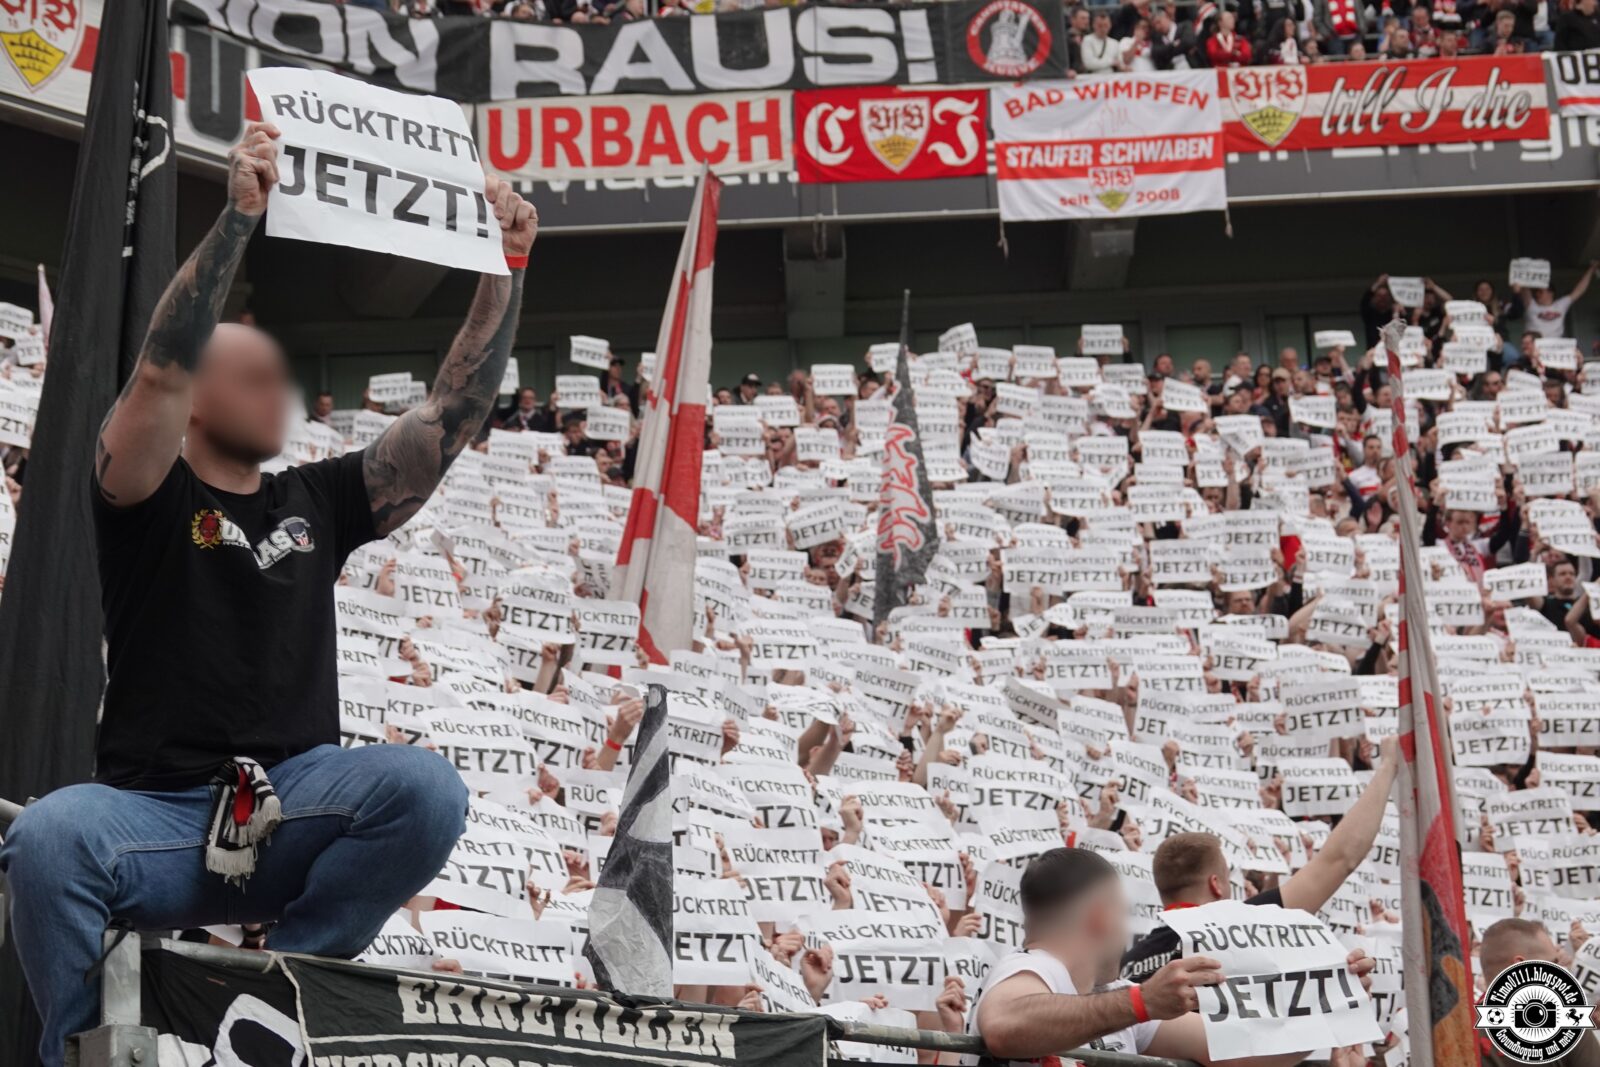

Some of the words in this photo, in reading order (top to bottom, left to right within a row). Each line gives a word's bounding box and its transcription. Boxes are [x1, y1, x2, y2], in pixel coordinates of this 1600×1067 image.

[490, 7, 937, 101] RAUS!
[1004, 88, 1064, 119] BAD
[1074, 81, 1209, 110] WIMPFEN
[1321, 67, 1407, 136] till
[1462, 67, 1531, 129] die
[271, 91, 479, 162] RÜCKTRITT
[488, 98, 783, 170] URBACH
[1006, 144, 1093, 167] STAUFER
[1100, 137, 1214, 164] SCHWABEN
[279, 146, 488, 238] JETZT!
[1060, 196, 1089, 206] seit
[1137, 189, 1180, 203] 2008
[794, 518, 843, 541] JETZT!
[1153, 561, 1208, 573] JETZT!
[401, 586, 462, 608] JETZT!
[1434, 602, 1481, 617] ETZT!
[338, 601, 399, 626] RÜCKTRITT
[752, 645, 818, 659] JETZT!
[1047, 664, 1108, 679] JETZT!
[1285, 688, 1358, 707] RÜCKTRITT
[1289, 706, 1362, 731] JETZT!
[756, 805, 818, 829] TZT!
[1496, 818, 1572, 835] JETZT!
[433, 927, 565, 963] RÜCKTRITT
[1187, 922, 1332, 953] RÜCKTRITT
[1209, 969, 1359, 1022] JETZT!
